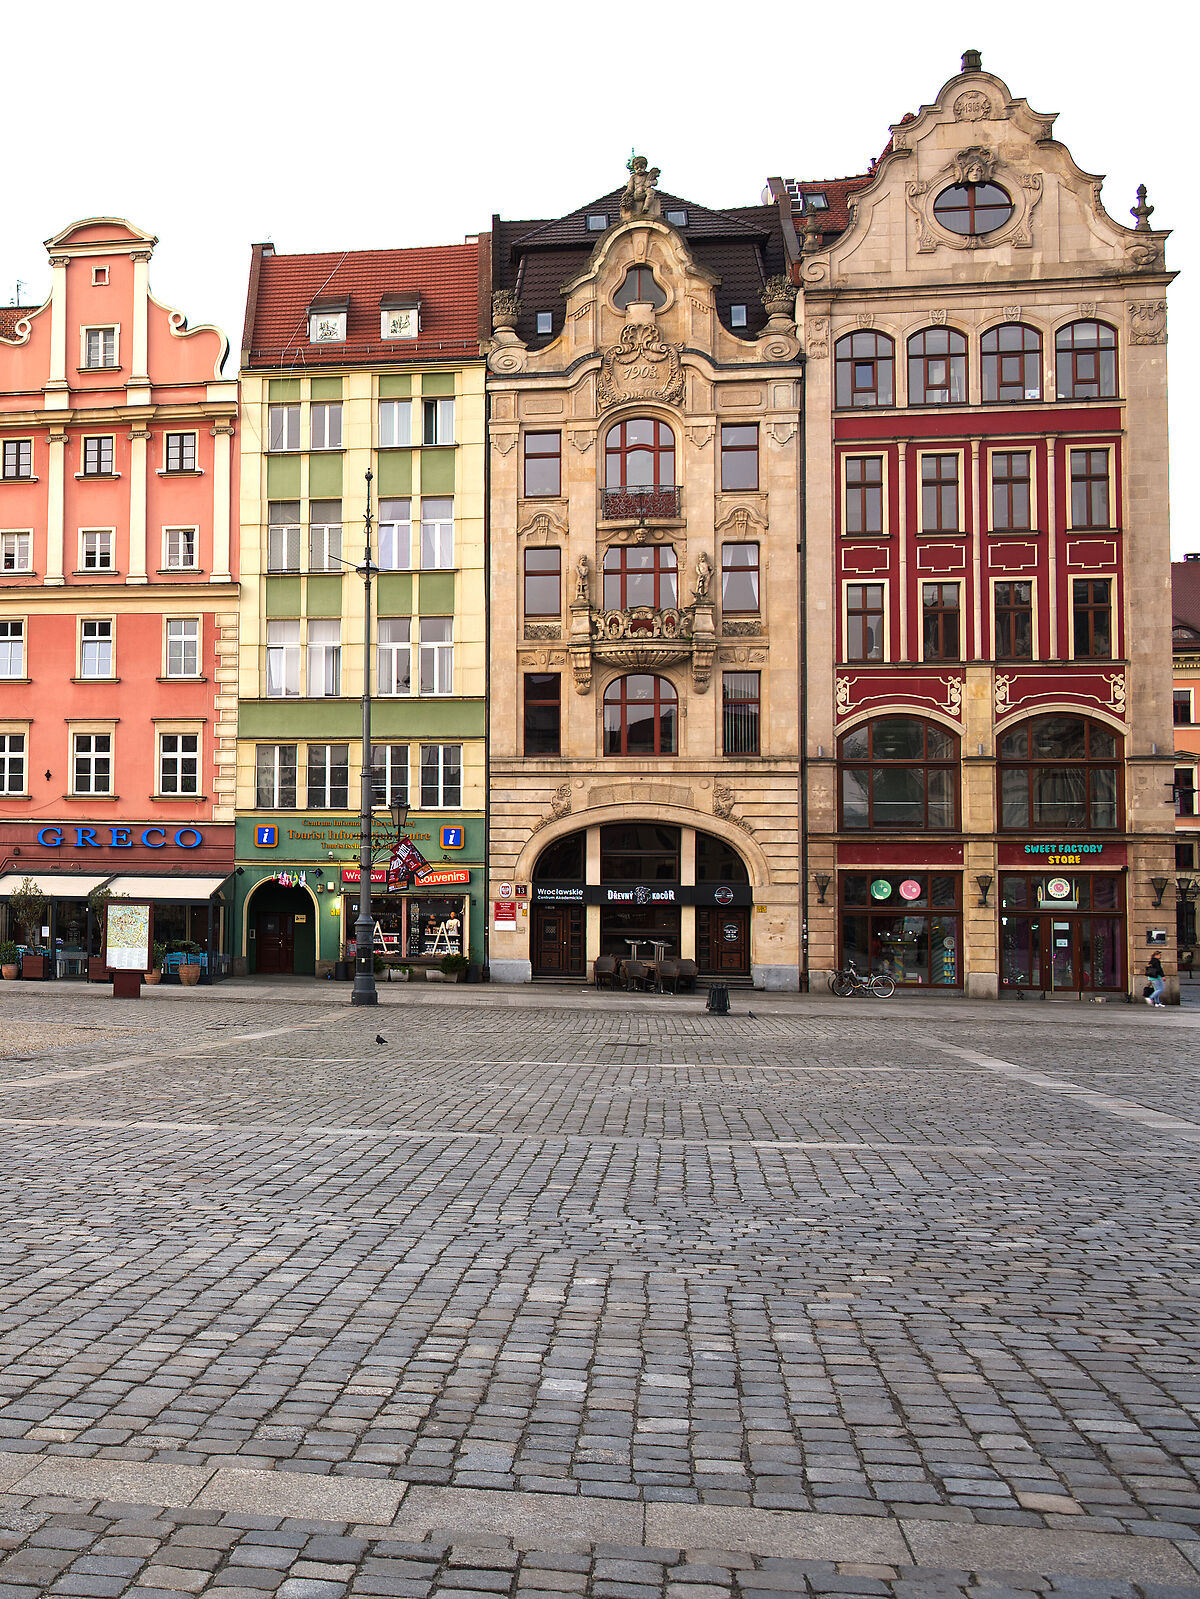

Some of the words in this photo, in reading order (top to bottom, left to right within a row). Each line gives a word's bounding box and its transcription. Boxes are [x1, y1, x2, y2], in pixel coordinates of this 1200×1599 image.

[36, 827, 203, 848] GRECO
[287, 829, 324, 840] Tourist
[1024, 844, 1057, 853] SWEET
[1058, 844, 1103, 853] FACTORY
[1047, 855, 1081, 864] STORE
